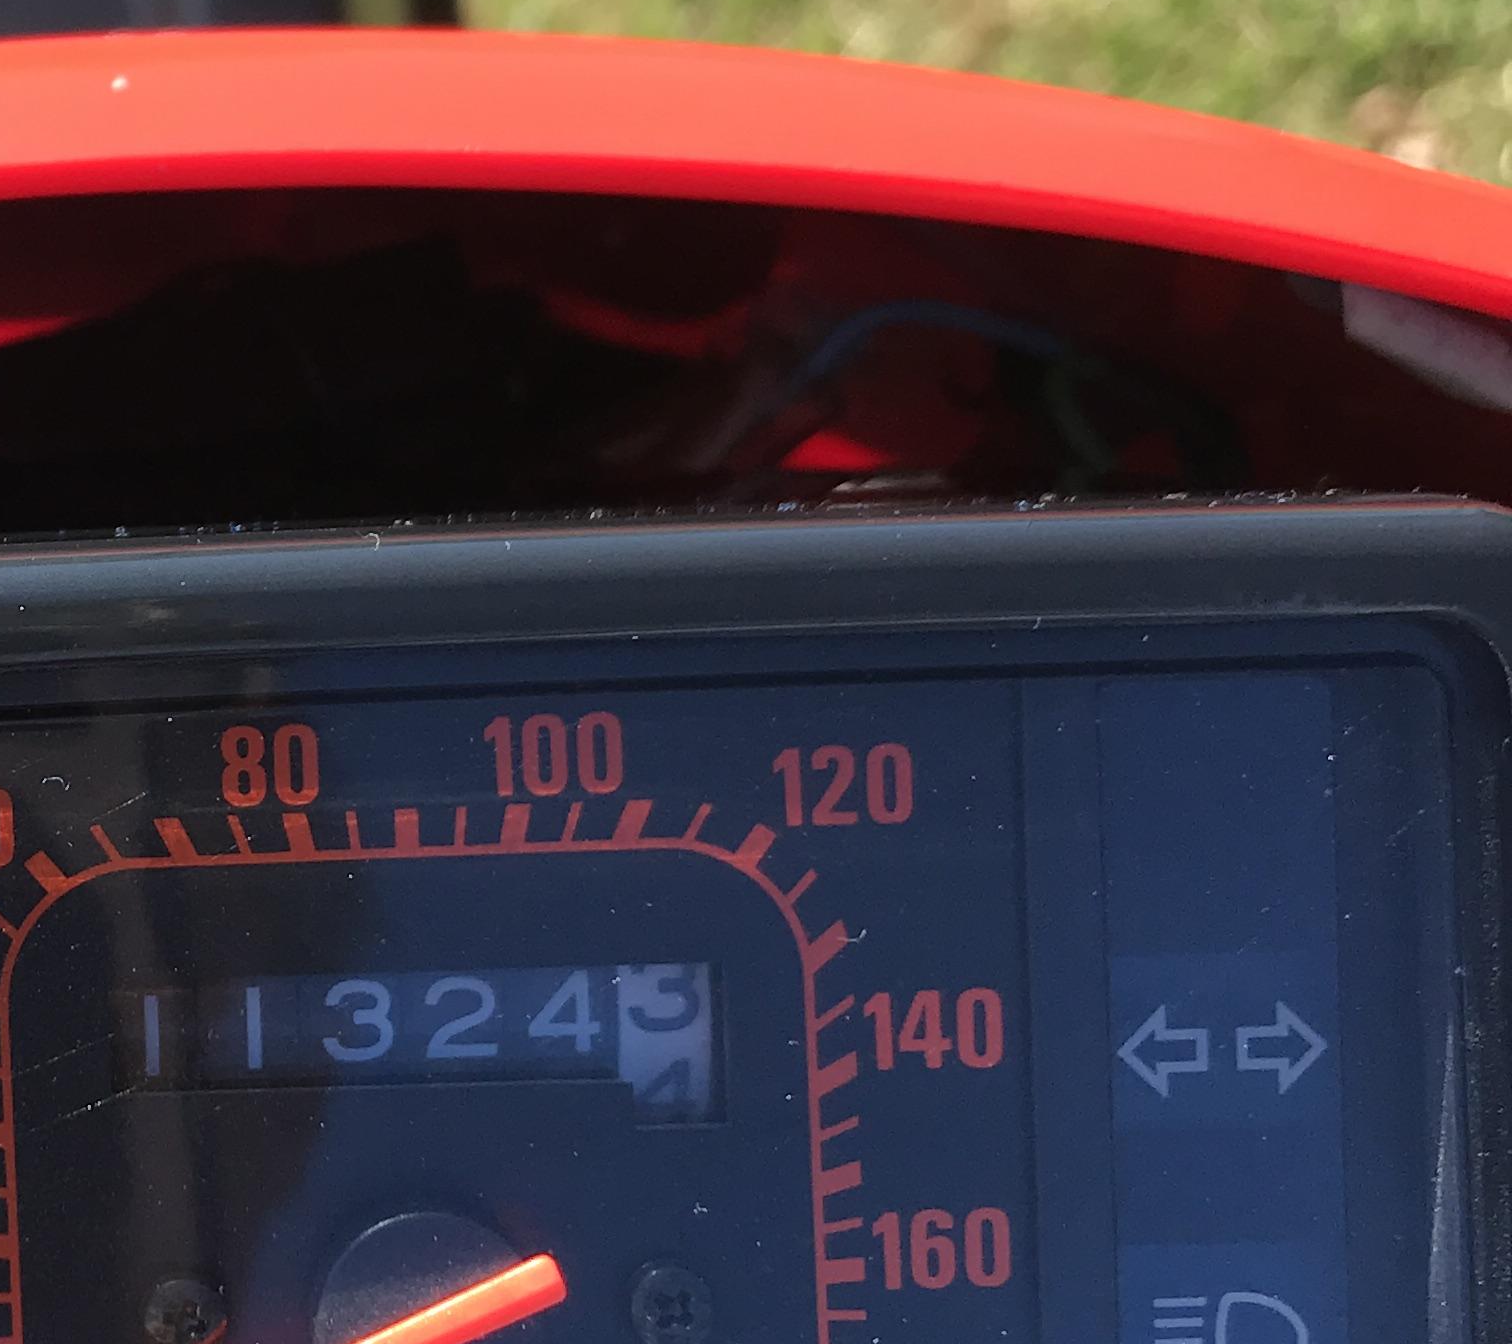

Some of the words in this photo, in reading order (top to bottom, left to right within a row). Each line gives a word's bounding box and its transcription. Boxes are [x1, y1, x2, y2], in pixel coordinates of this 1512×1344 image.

[220, 723, 320, 807] 80
[483, 711, 624, 797] 100
[772, 743, 912, 827] 120
[863, 988, 1004, 1071] 140
[872, 1207, 1012, 1290] 160
